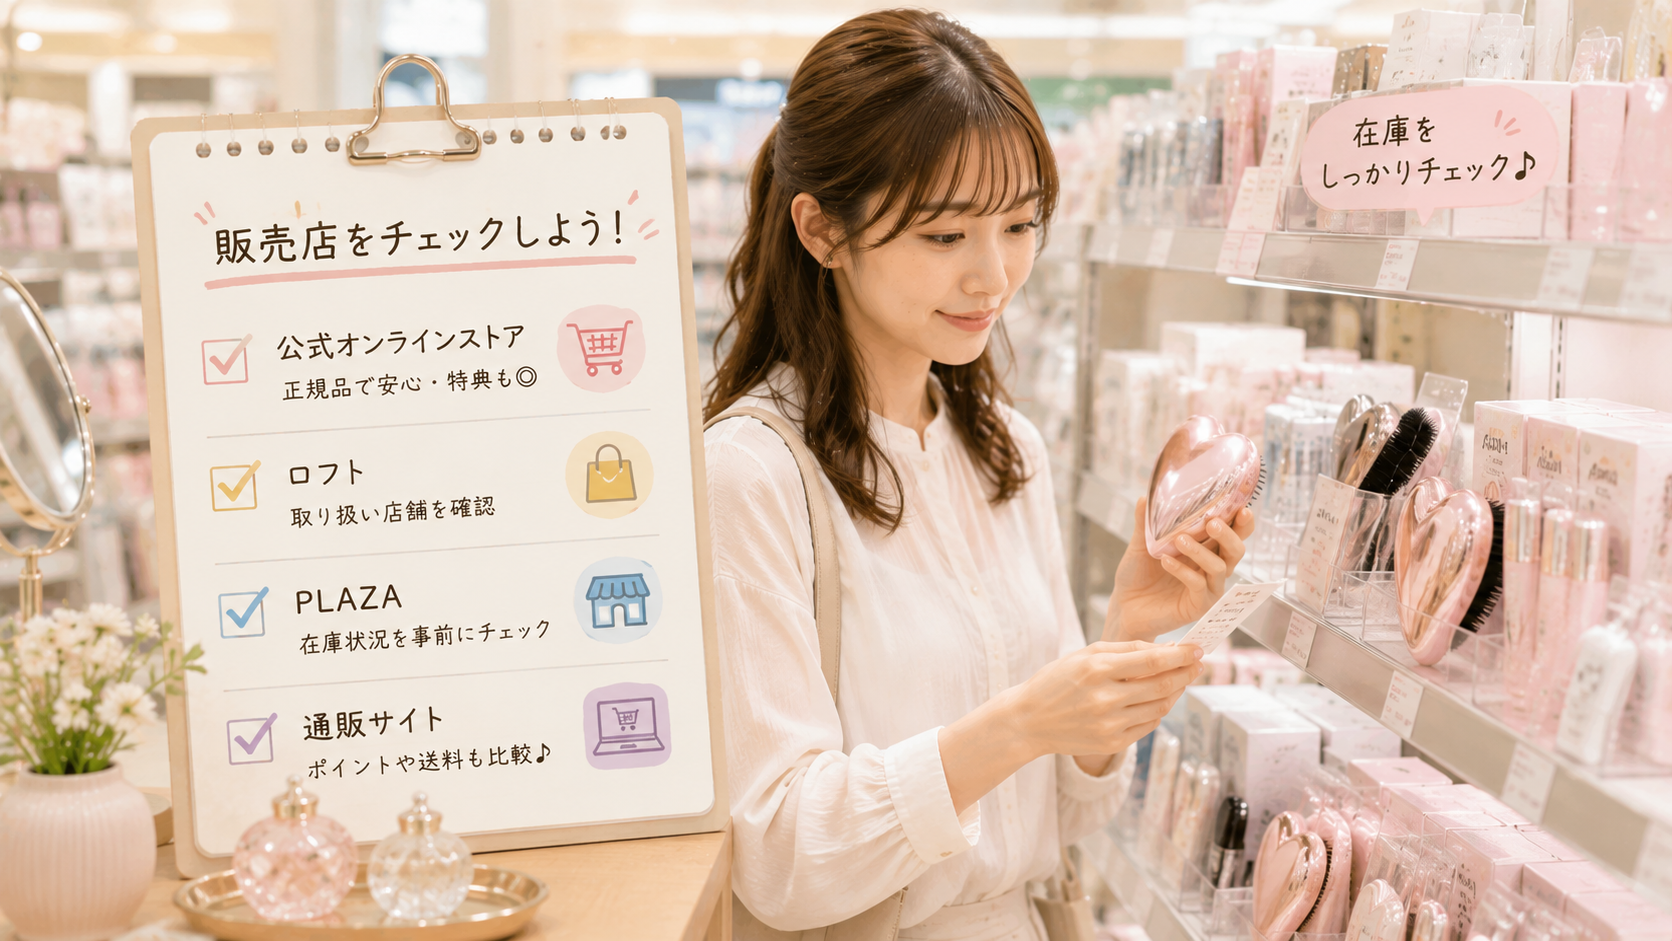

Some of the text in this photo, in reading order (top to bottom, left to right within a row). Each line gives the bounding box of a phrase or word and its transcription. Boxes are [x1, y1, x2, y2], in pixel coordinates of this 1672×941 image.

[214, 209, 622, 266] 販売店をチェックしよう！
[276, 323, 524, 361] 公式オンラインストア
[289, 459, 363, 486] ロフト
[290, 496, 496, 529] 取り扱い店舗を確認
[295, 584, 403, 615] PLAZA
[299, 619, 550, 656] 在庫状況を事前にチェック
[303, 706, 442, 742] 通販サイト
